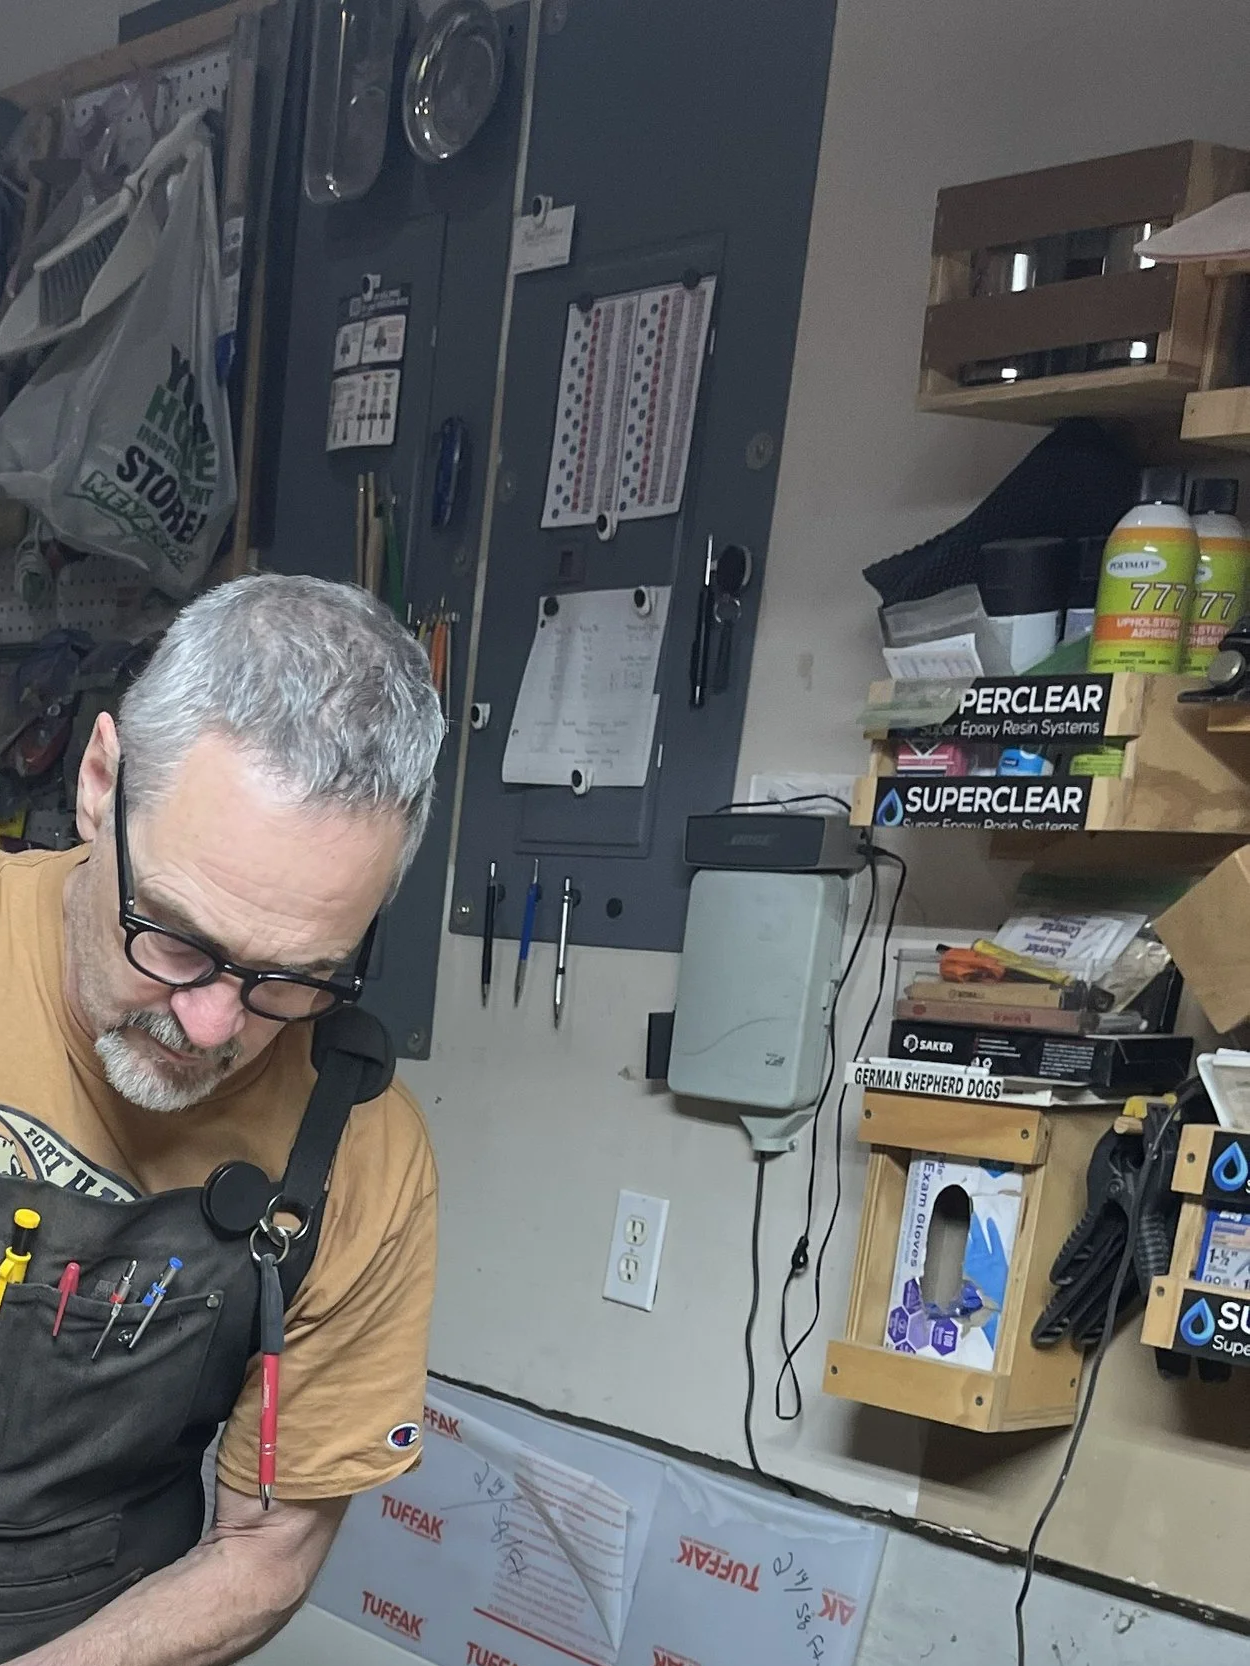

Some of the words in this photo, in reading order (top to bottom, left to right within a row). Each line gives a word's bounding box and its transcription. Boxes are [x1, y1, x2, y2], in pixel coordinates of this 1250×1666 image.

[116, 445, 208, 545] STORE!
[1131, 581, 1188, 611] 777
[1193, 590, 1236, 620] 77
[958, 684, 1104, 715] PERCLEAR
[960, 720, 1000, 738] Epoxy
[1002, 719, 1038, 736] Resin
[1041, 717, 1100, 737] Systems
[905, 785, 1084, 815] SUPERCLEAR
[919, 1040, 954, 1053] SAKER
[855, 1067, 900, 1089] GERMAN
[904, 1071, 964, 1094] SHEPHERD
[967, 1077, 1001, 1099] DOGS
[23, 1127, 74, 1177] FORT
[915, 1161, 935, 1208] Exam
[910, 1212, 926, 1268] Gloves
[1212, 1334, 1250, 1357] Supe
[423, 1405, 461, 1438] FFAK
[382, 1494, 444, 1540] TUFFAK
[677, 1540, 760, 1592] TUFFAK
[362, 1590, 423, 1635] TUFFAK
